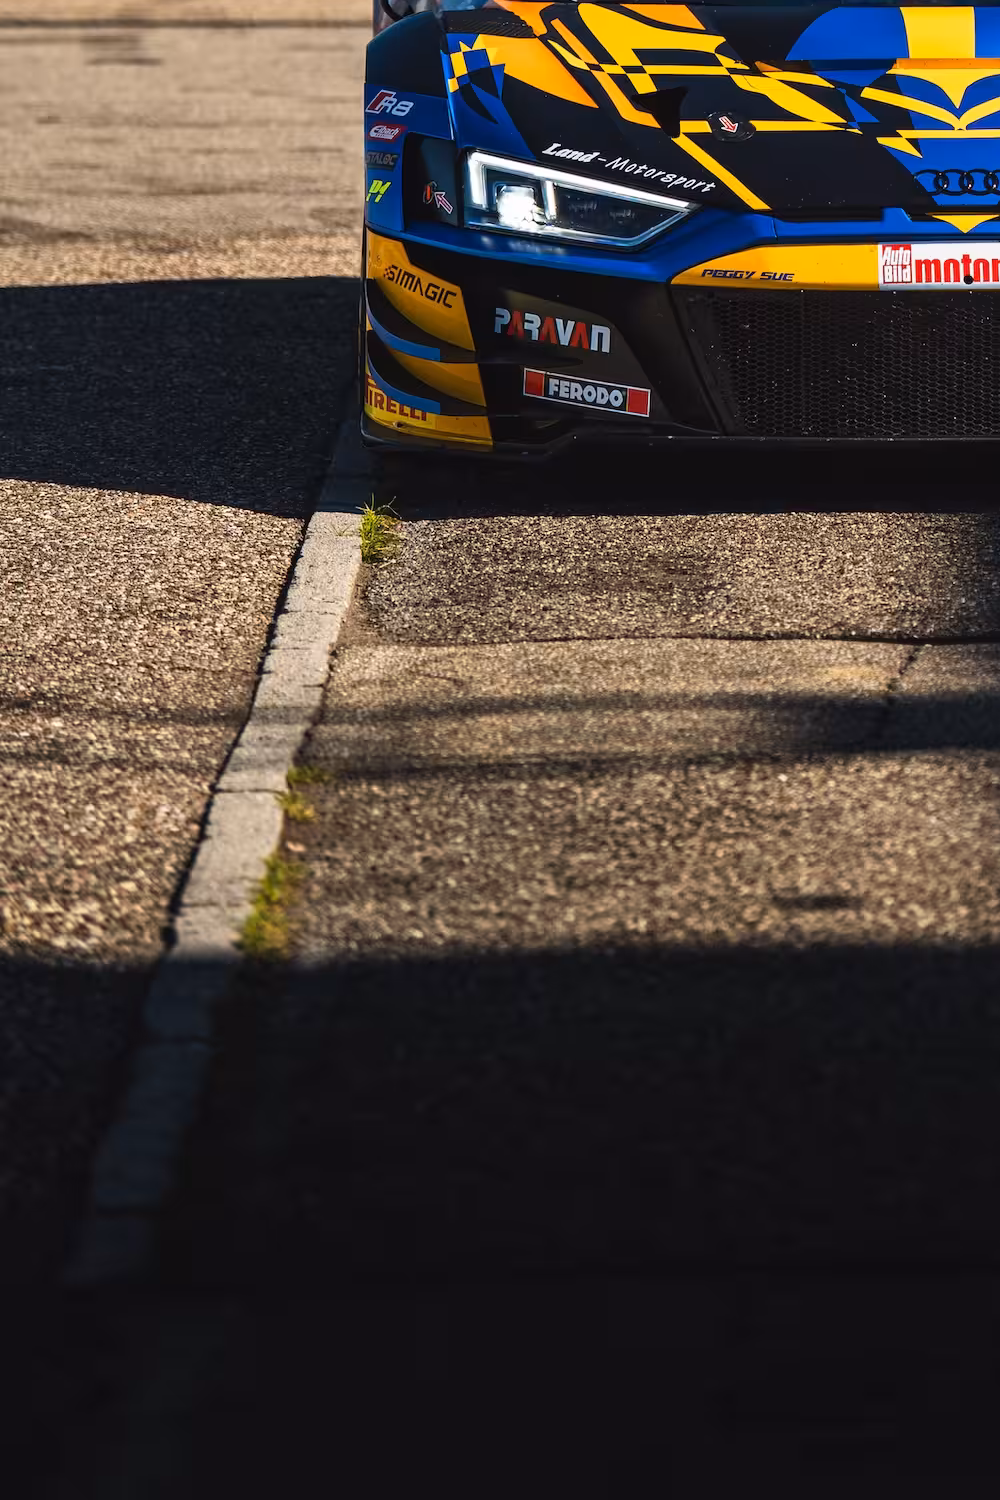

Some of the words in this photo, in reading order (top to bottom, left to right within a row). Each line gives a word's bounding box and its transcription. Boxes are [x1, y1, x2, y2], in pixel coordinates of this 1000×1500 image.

[369, 90, 414, 116] R8
[384, 264, 457, 308] SIMAGIC
[701, 269, 757, 280] PEGGY
[760, 272, 795, 282] SUE
[494, 307, 611, 353] PARAVAN
[548, 377, 624, 407] FERODO
